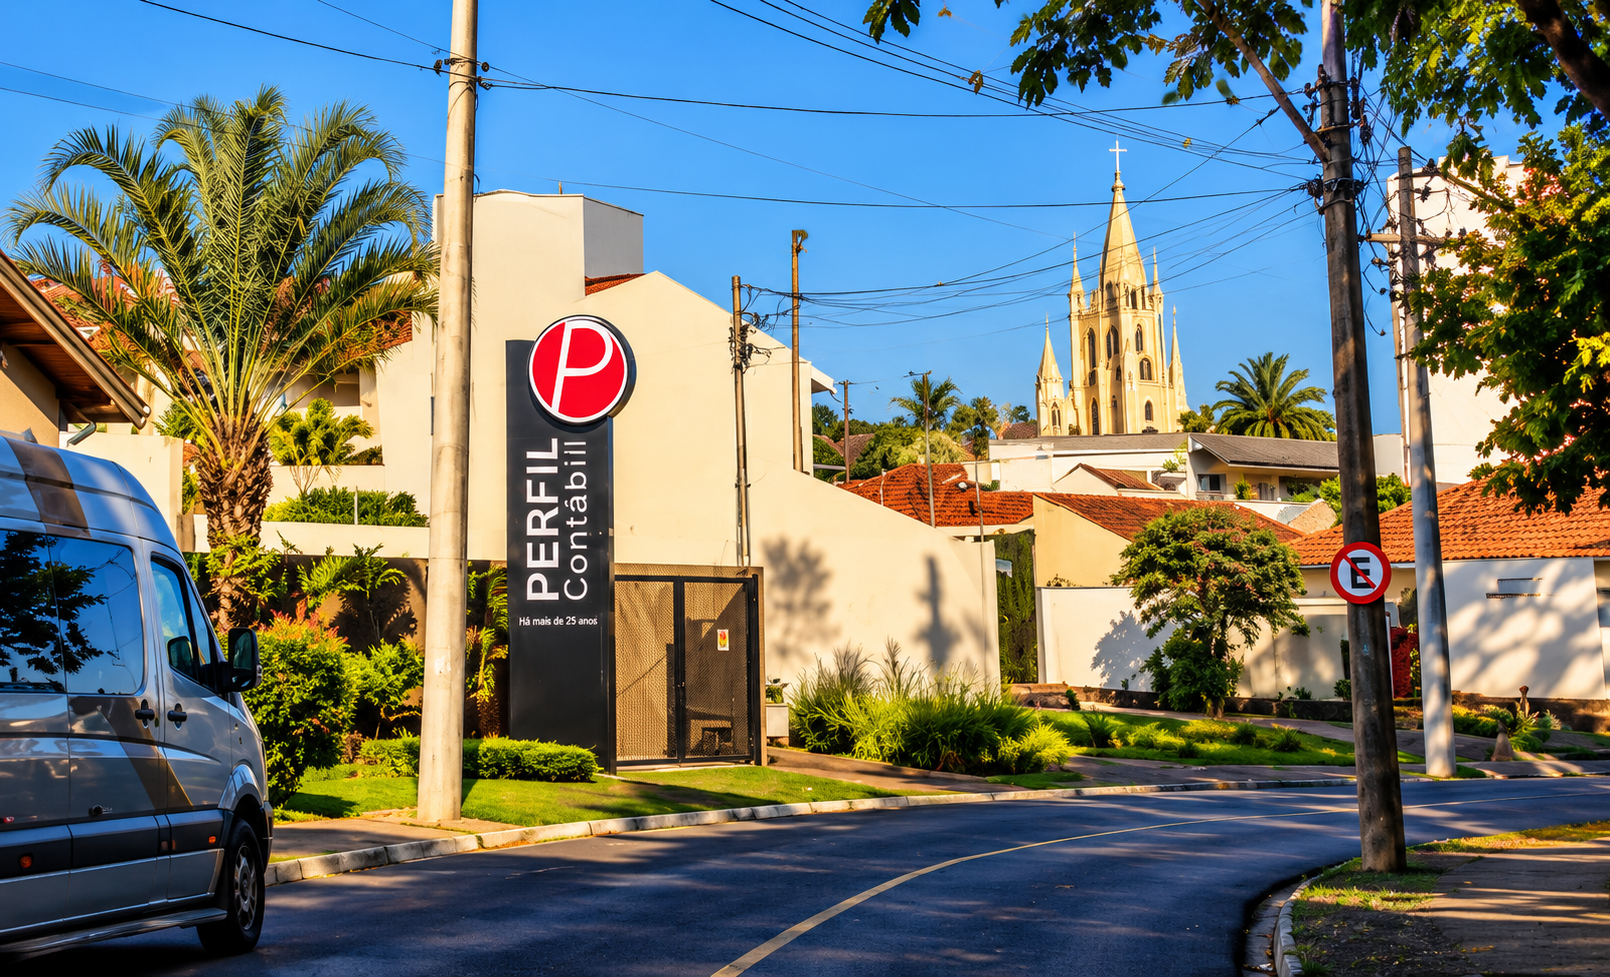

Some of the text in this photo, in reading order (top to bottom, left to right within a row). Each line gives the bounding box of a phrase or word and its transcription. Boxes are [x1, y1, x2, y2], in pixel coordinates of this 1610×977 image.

[551, 319, 613, 413] P
[526, 437, 560, 601] PERFIL
[1350, 557, 1374, 589] E
[519, 616, 598, 626] Há mais de 25 anos
